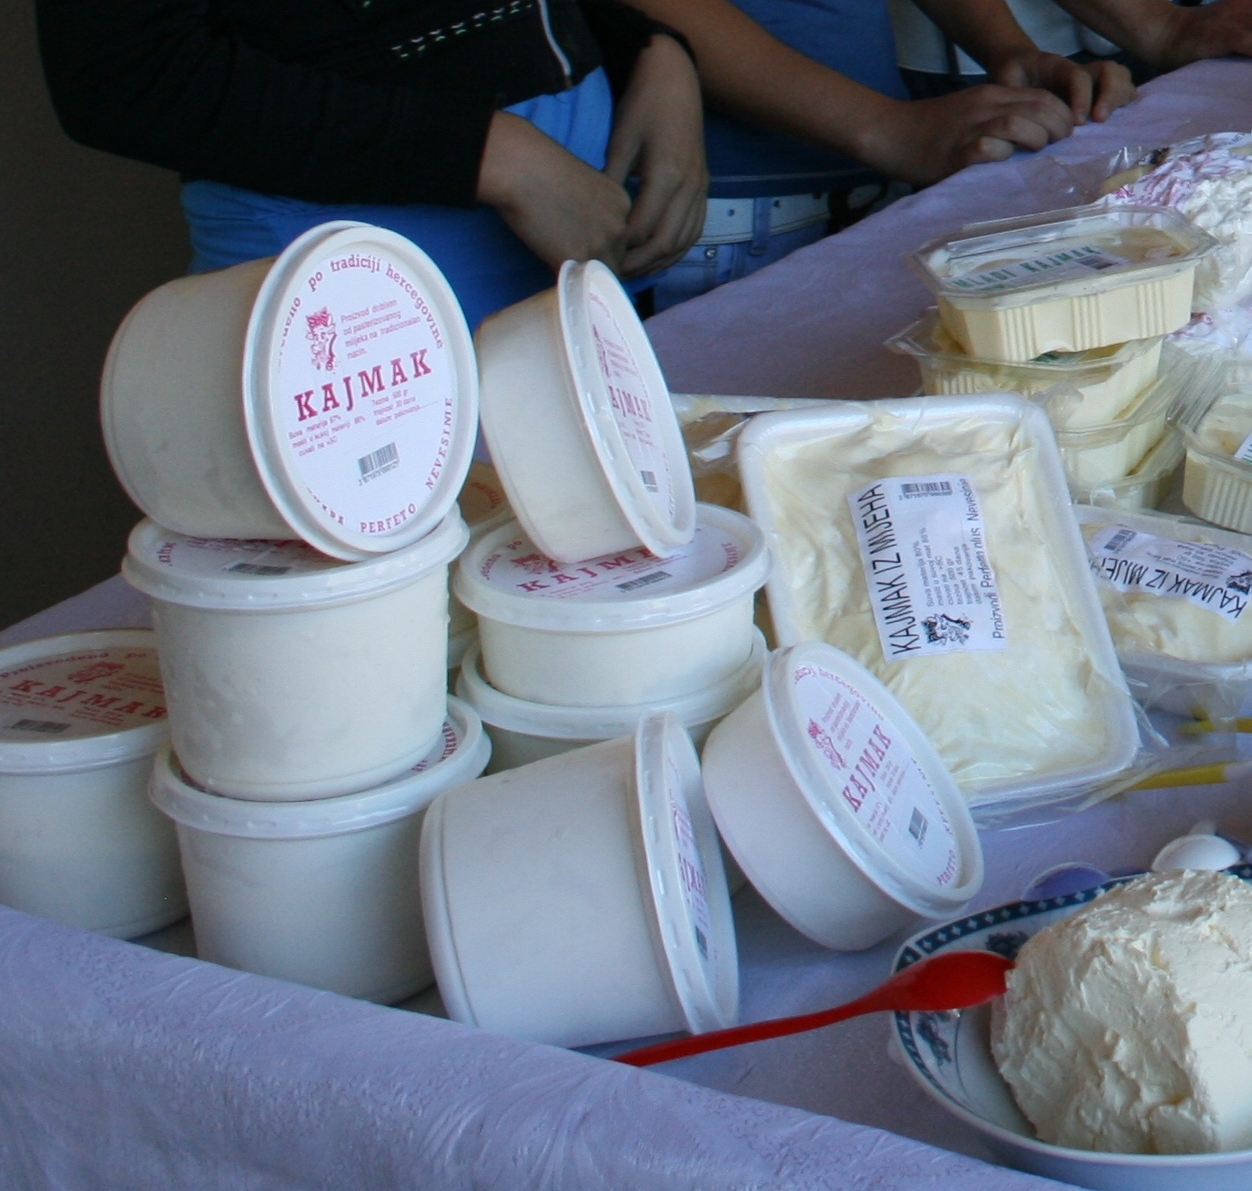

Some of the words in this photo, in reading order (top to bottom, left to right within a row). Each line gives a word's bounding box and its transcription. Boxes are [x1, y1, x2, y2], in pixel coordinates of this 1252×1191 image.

[1020, 246, 1101, 273] KAJMAK
[308, 271, 323, 292] po
[330, 254, 381, 273] tradiciji
[386, 264, 444, 349] hercegovine
[294, 348, 432, 422] KAJMAK
[360, 503, 417, 533] PERFETO
[857, 483, 898, 555] MIJEHA
[872, 552, 902, 575] IZ
[1146, 569, 1169, 589] IZ
[875, 574, 921, 655] KAJMAK
[1167, 573, 1248, 618] KAJMAK
[842, 724, 892, 812] KAJMAK
